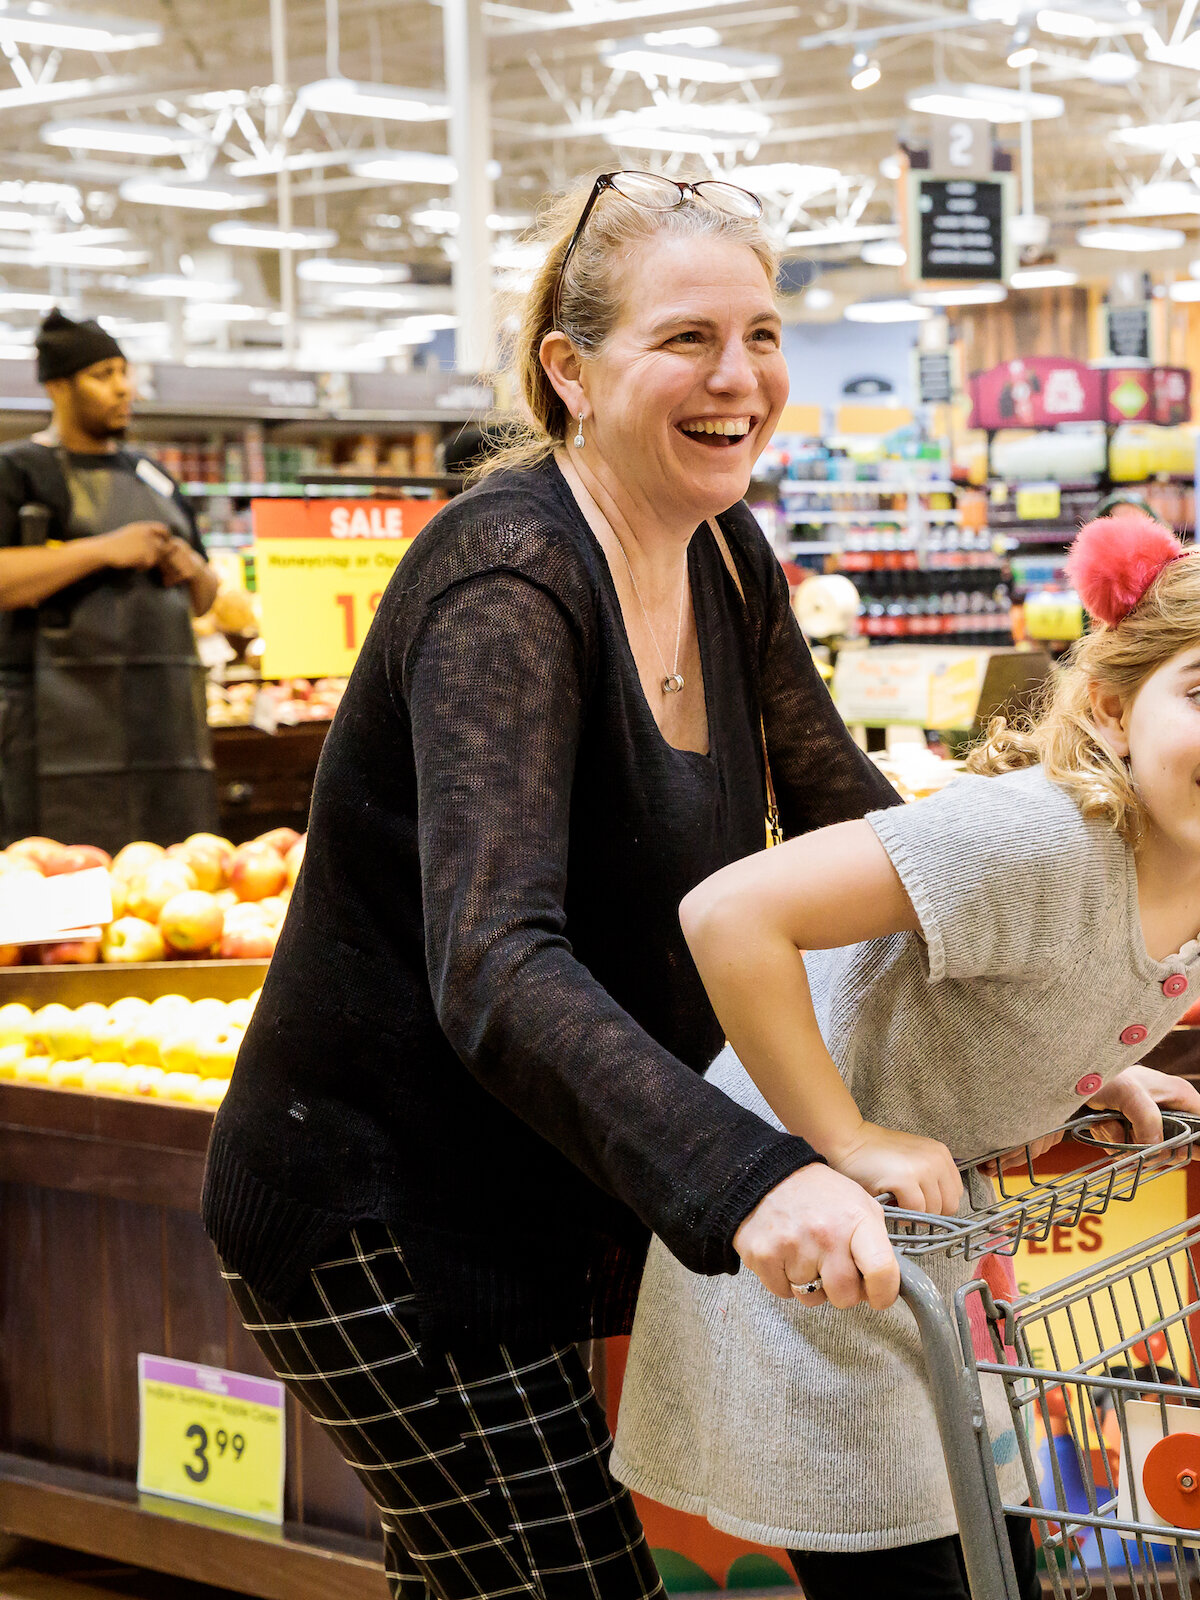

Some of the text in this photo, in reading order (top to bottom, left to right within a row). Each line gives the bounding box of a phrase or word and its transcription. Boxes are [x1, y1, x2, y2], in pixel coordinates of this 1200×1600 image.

[949, 122, 974, 168] 2
[330, 507, 403, 538] SALE
[268, 554, 348, 571] Honeycrisp
